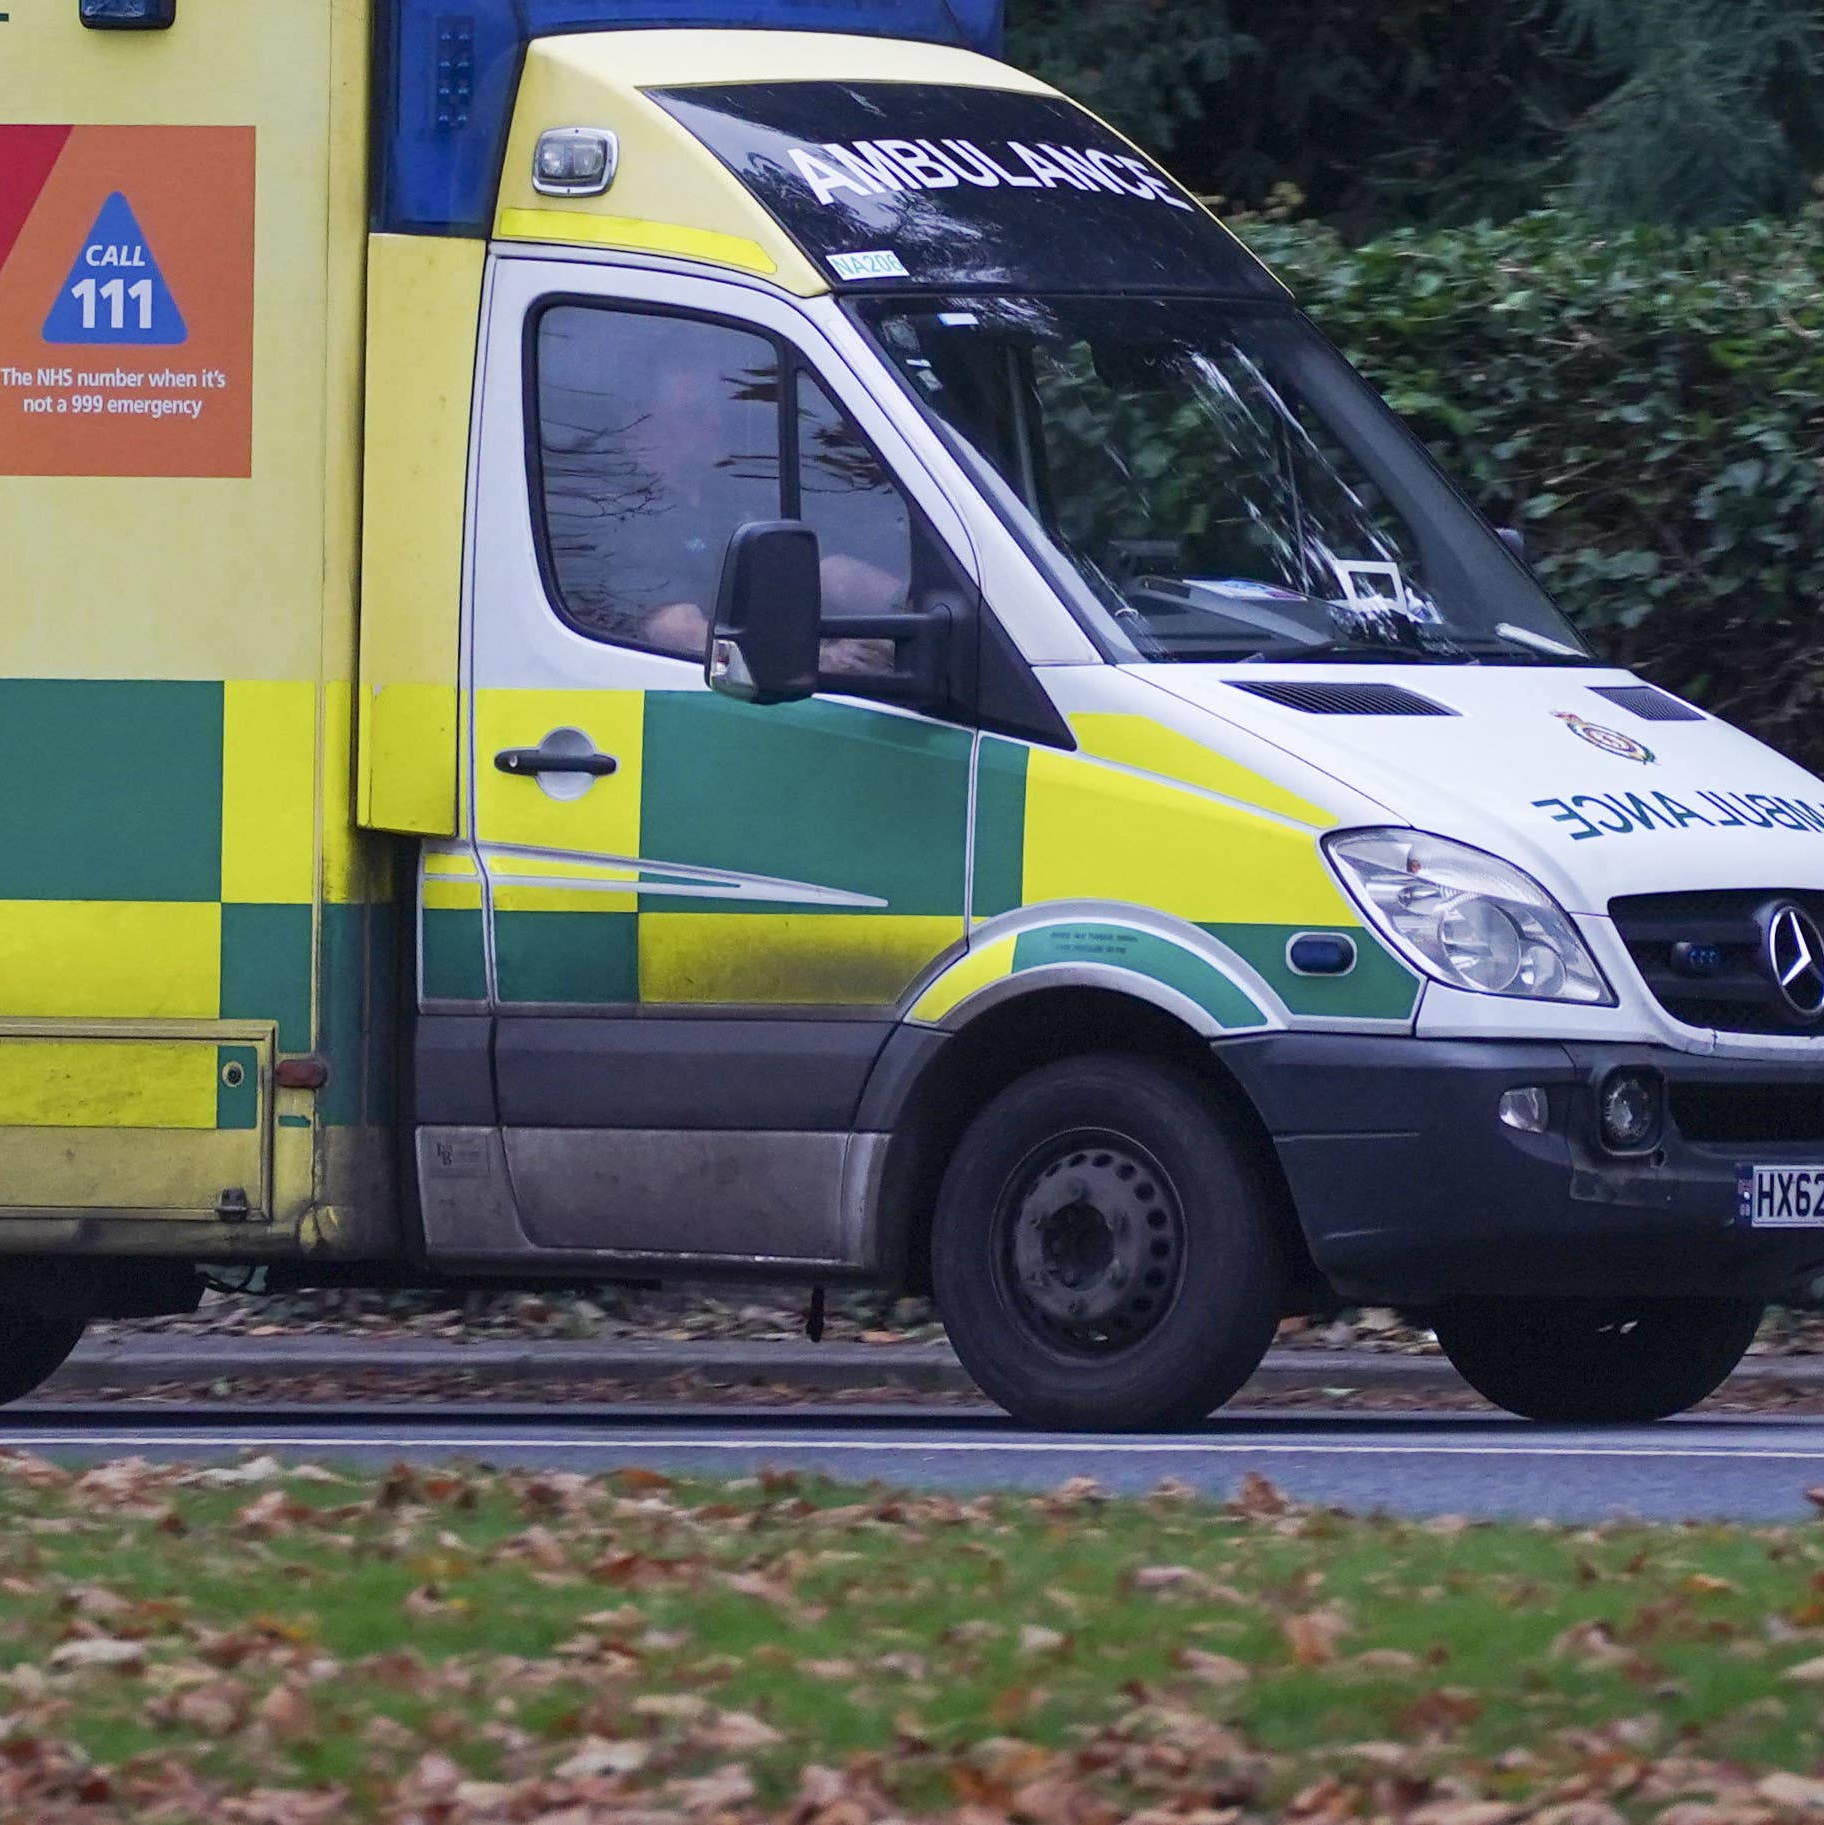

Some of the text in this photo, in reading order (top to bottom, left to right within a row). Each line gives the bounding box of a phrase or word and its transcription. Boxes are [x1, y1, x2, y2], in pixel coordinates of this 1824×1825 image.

[787, 138, 1195, 213] AMBULANCE
[85, 245, 145, 267] CALL
[71, 278, 152, 329] 111
[0, 367, 226, 388] The NHS number when it's
[23, 395, 203, 419] not a 999 emergency
